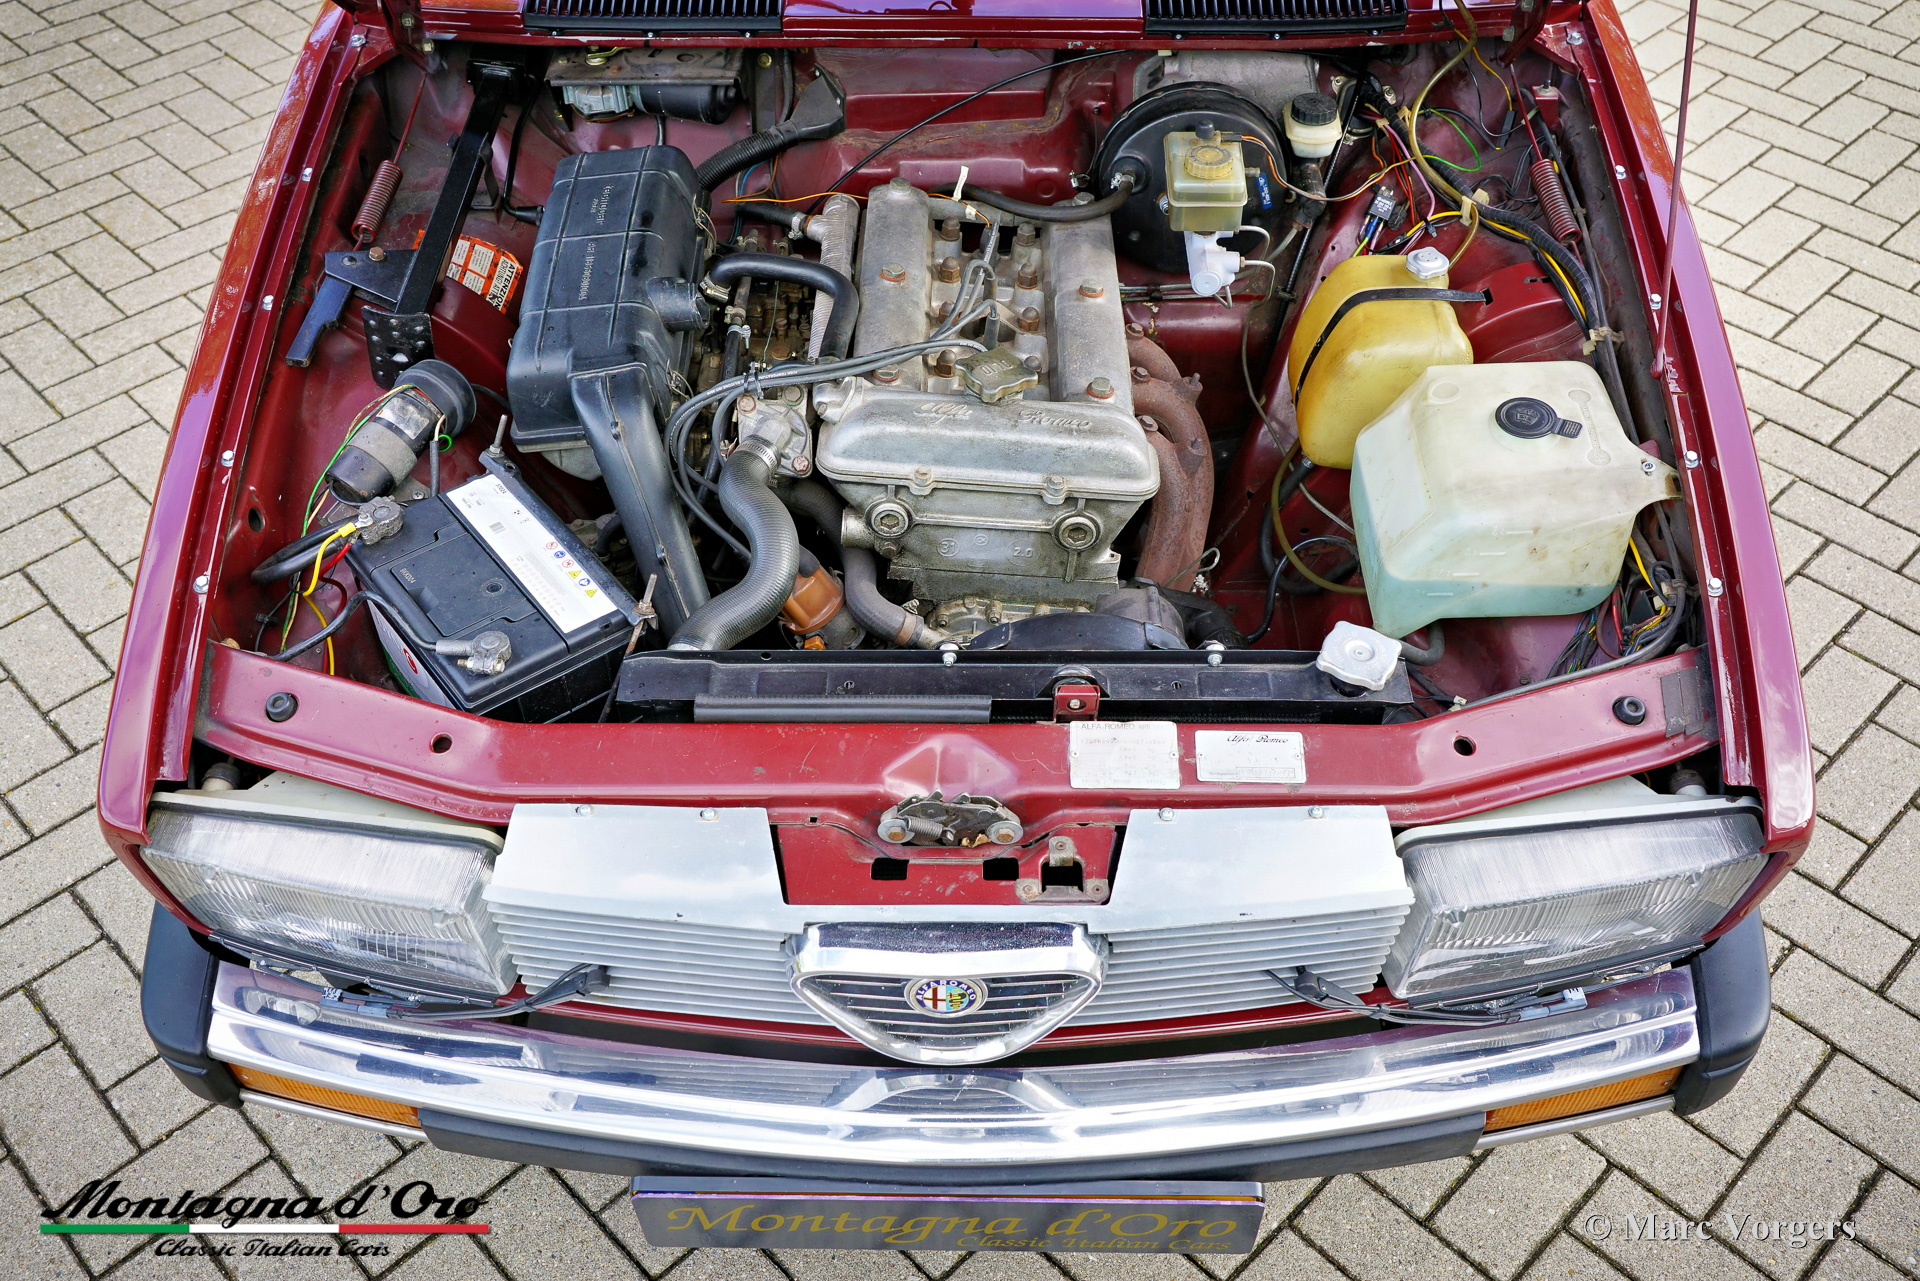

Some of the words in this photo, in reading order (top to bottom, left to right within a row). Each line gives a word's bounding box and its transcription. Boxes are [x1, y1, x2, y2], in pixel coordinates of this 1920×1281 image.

[979, 359, 1013, 376] OLIO
[913, 403, 973, 424] Alfa
[1018, 409, 1093, 429] Romeo
[940, 541, 957, 553] 31
[1012, 546, 1034, 558] 2.0
[1227, 734, 1250, 745] Alfa
[1255, 734, 1289, 744] Romeo
[915, 981, 938, 1001] ALFA
[940, 980, 977, 1001] ROMEO
[666, 1204, 1029, 1244] Montagna
[1047, 1209, 1238, 1239] d'Oro
[955, 1235, 1051, 1250] Classic
[1062, 1237, 1159, 1251] Italian
[1168, 1238, 1232, 1252] Cars
